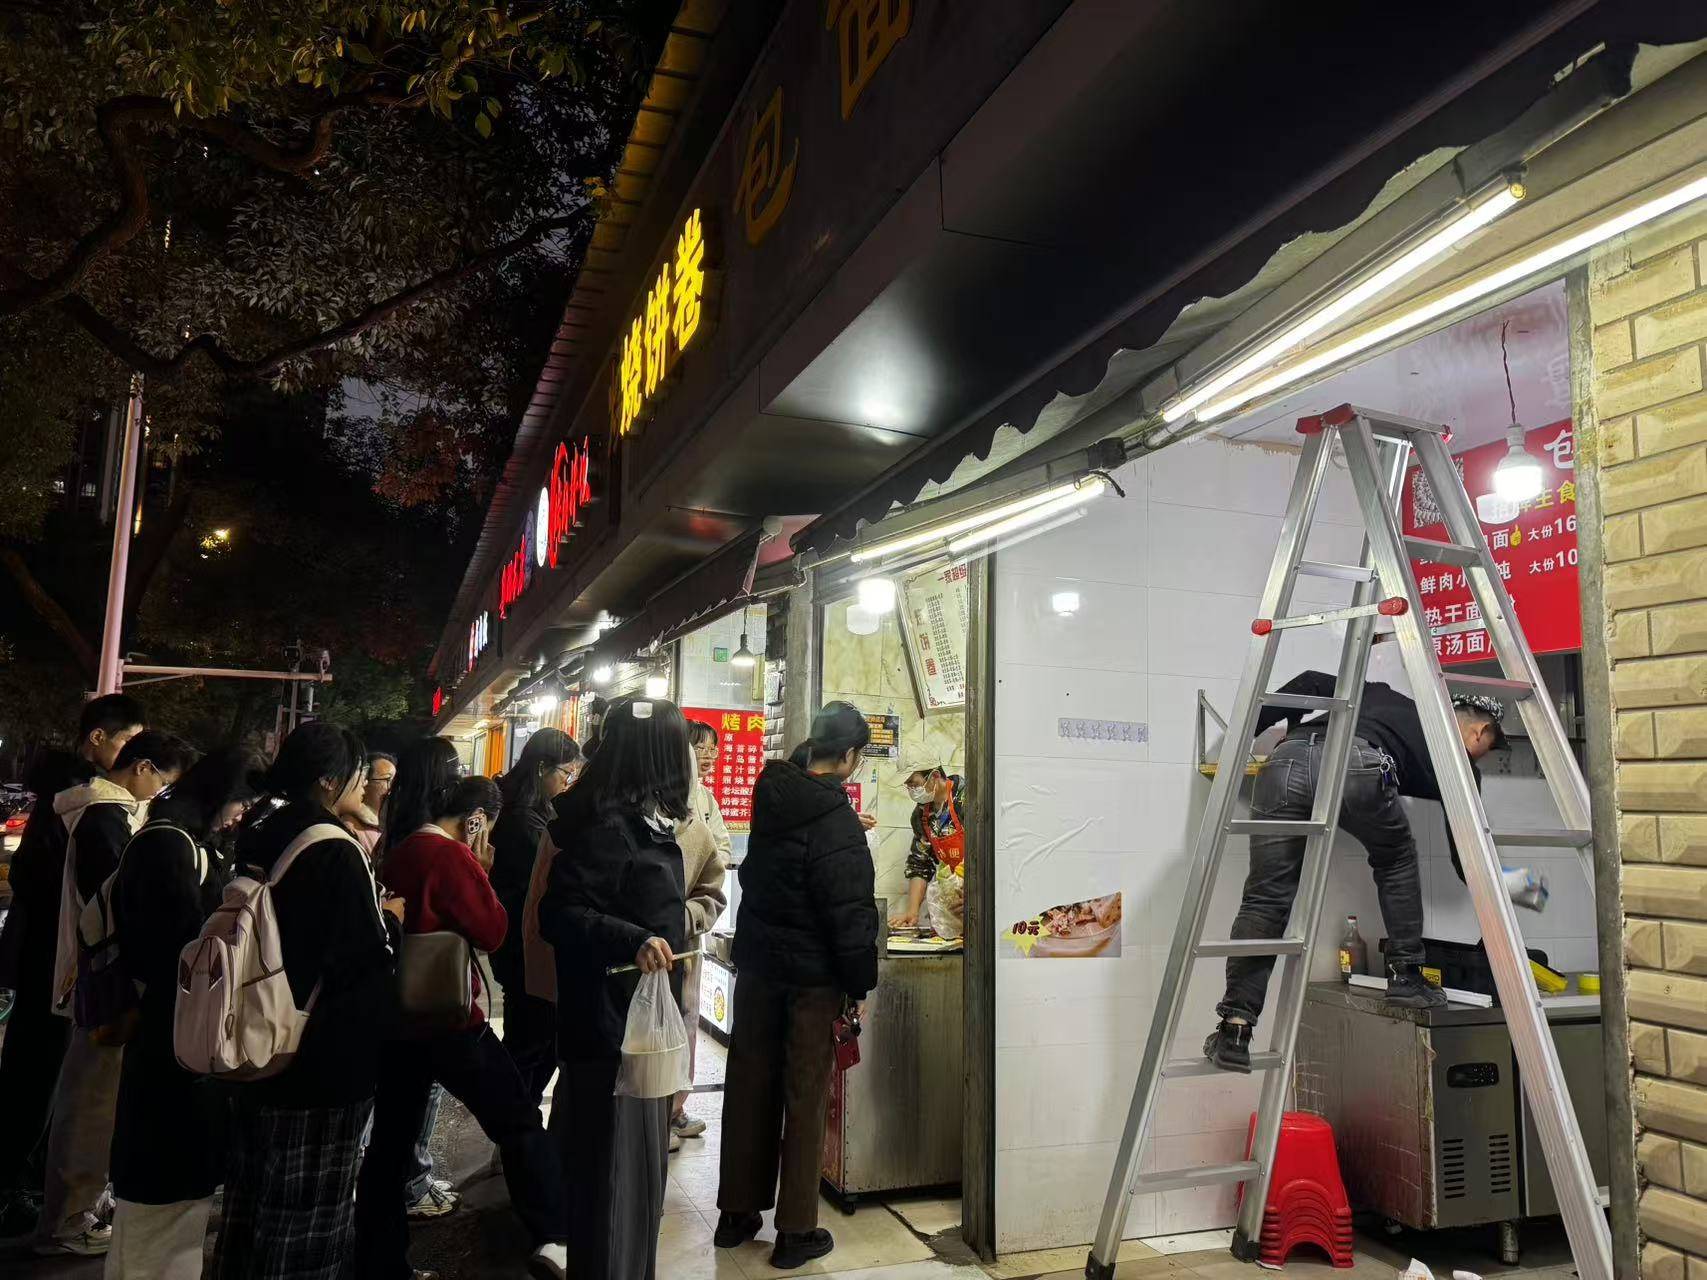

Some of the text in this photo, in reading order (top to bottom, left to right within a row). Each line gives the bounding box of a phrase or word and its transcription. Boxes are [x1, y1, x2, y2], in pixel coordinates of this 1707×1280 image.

[721, 713, 765, 732] 烤肉
[721, 797, 752, 807] 奶香芝
